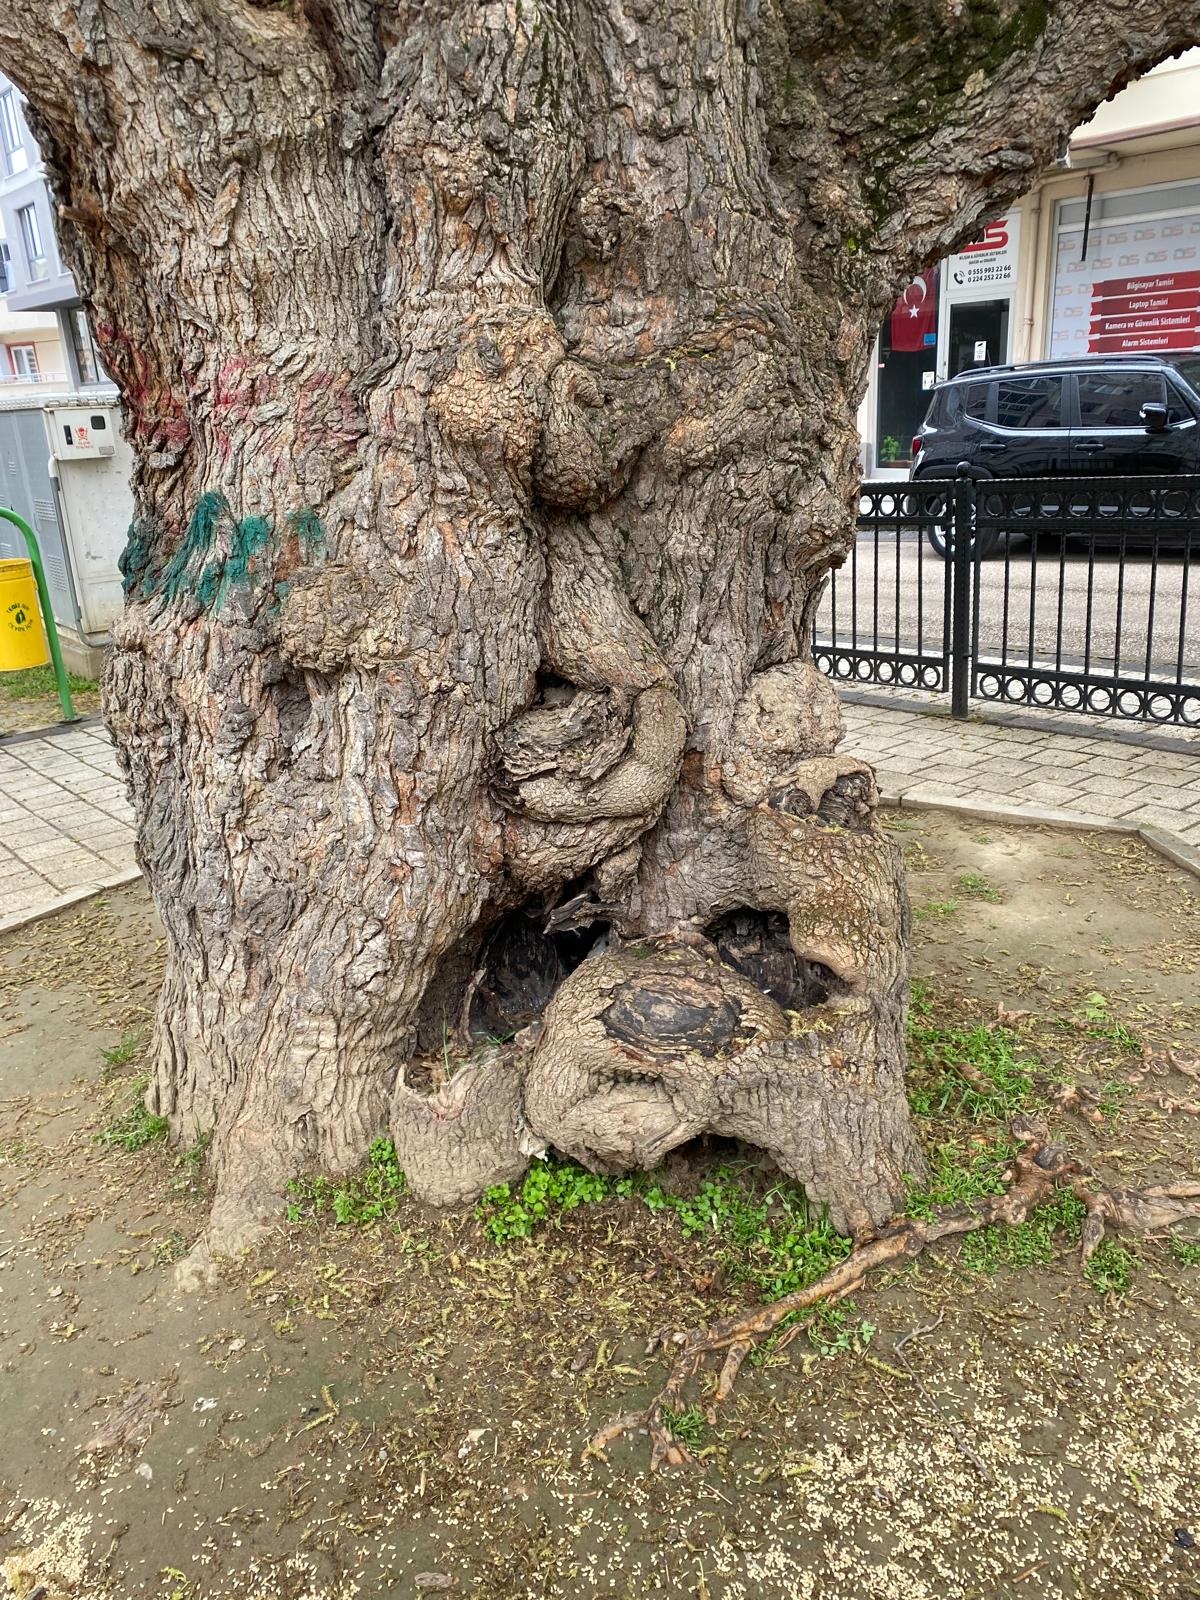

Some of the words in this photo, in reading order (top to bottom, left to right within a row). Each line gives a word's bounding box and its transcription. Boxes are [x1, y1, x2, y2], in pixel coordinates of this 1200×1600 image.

[1126, 280, 1155, 291] Bilgisayar
[1155, 278, 1174, 287] Tamiri
[1128, 301, 1149, 310] Laptop
[1149, 298, 1168, 307] Tamiri
[1105, 320, 1126, 330] Kamera
[1135, 317, 1160, 328] Güvenlik
[1160, 315, 1191, 325] Sistemleri
[1122, 339, 1139, 347] Alarm
[1139, 336, 1169, 346] Sistemleri
